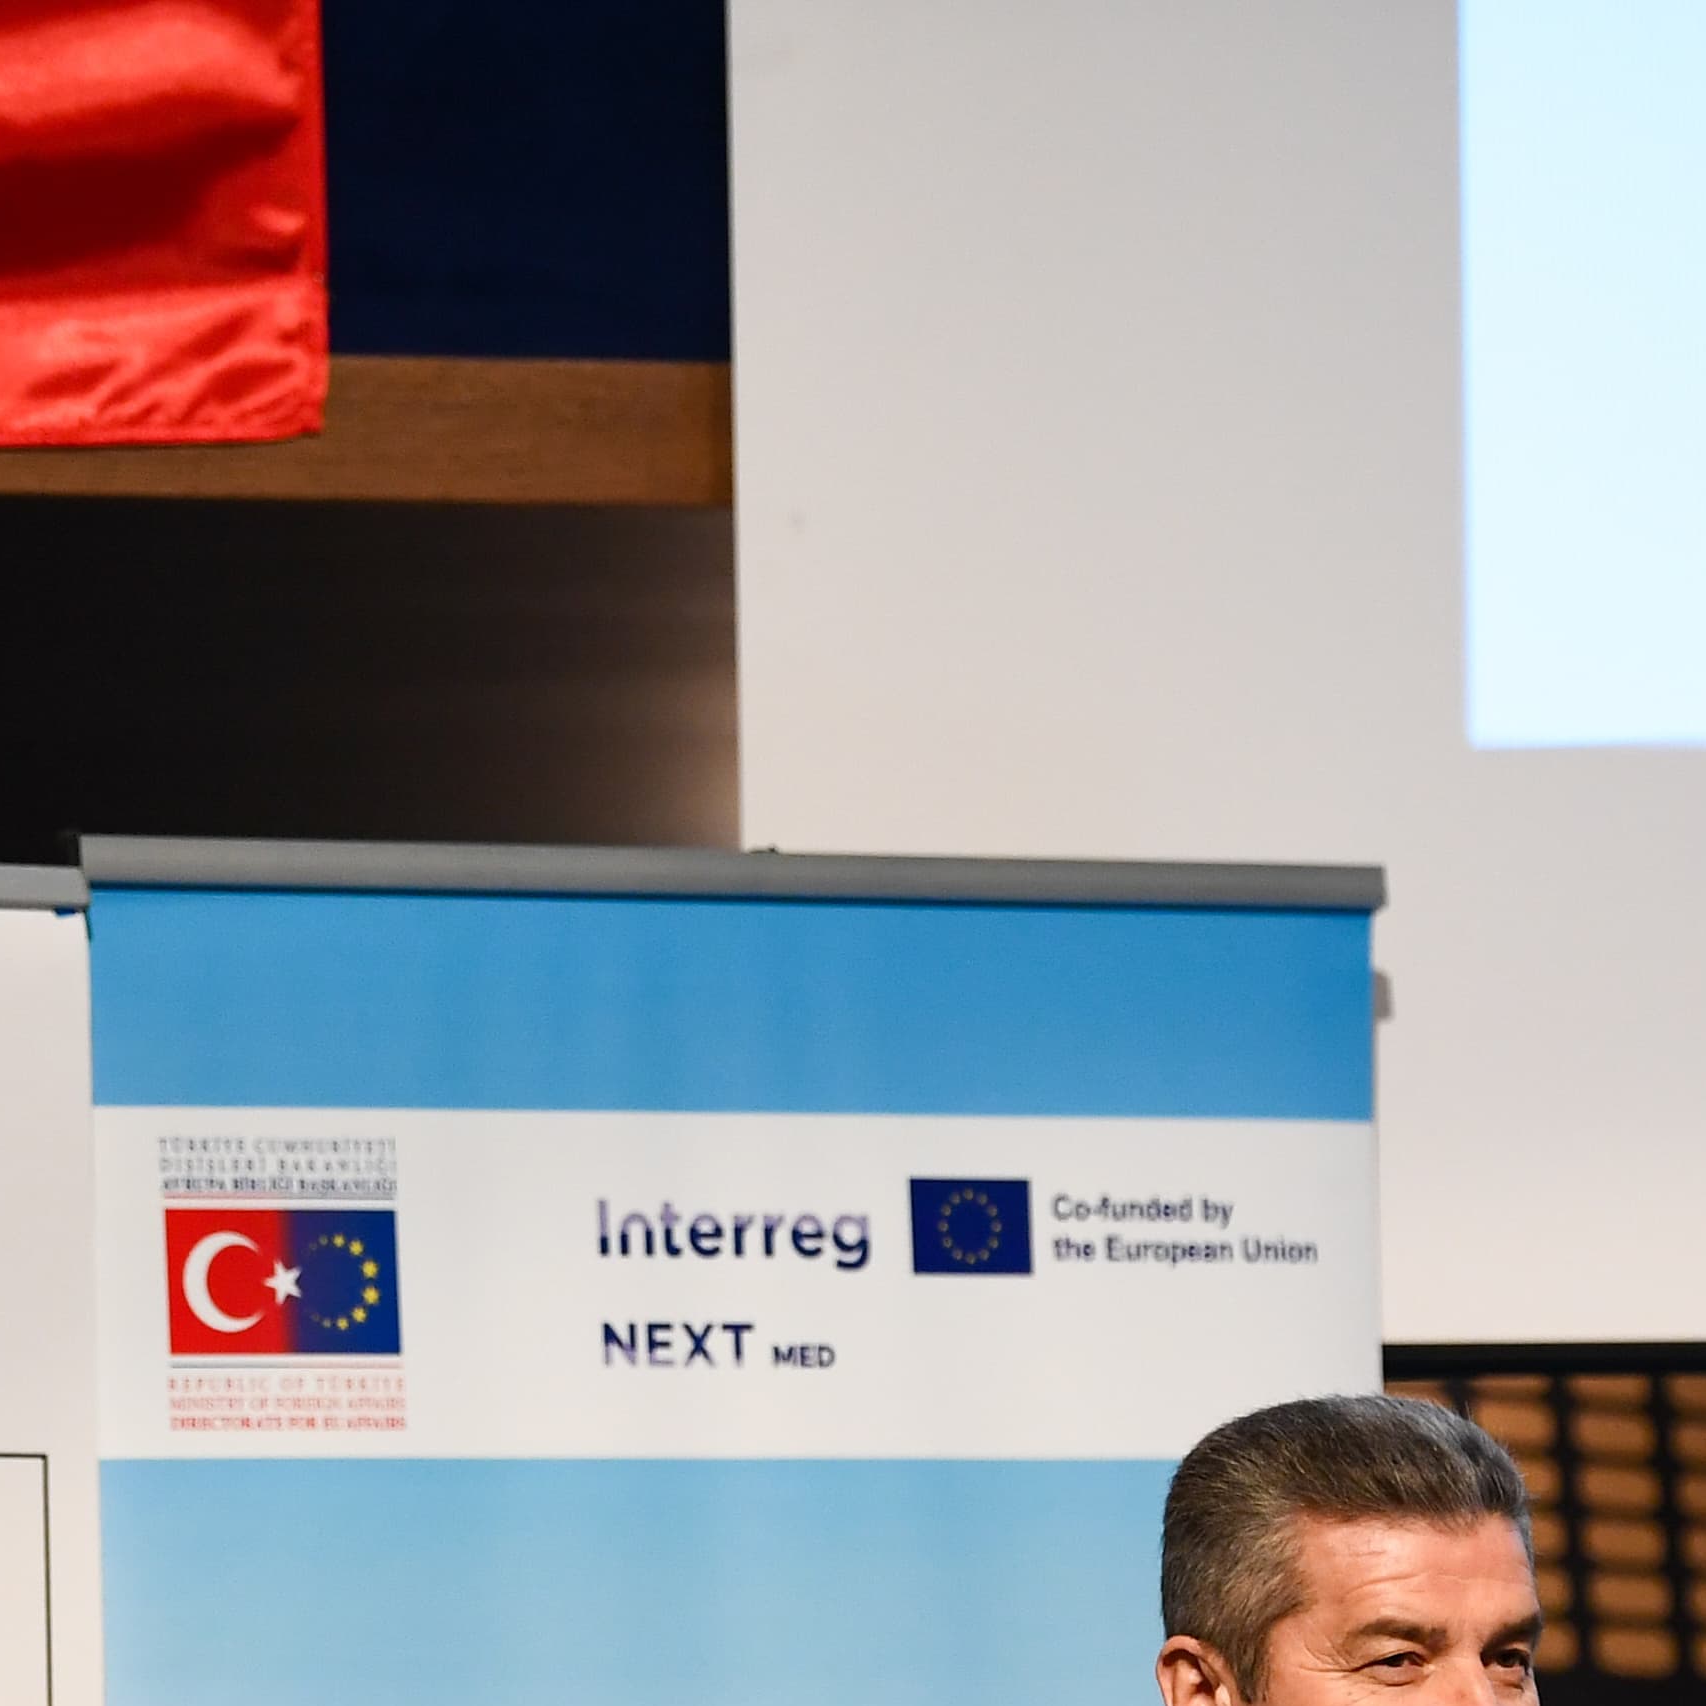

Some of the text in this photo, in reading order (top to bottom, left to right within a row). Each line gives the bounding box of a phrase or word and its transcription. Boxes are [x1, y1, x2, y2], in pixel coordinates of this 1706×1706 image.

[1053, 1193, 1235, 1230] Co-funded by
[595, 1198, 870, 1271] Interreg
[1053, 1235, 1319, 1268] the European Union
[601, 1321, 837, 1369] NEXT MED
